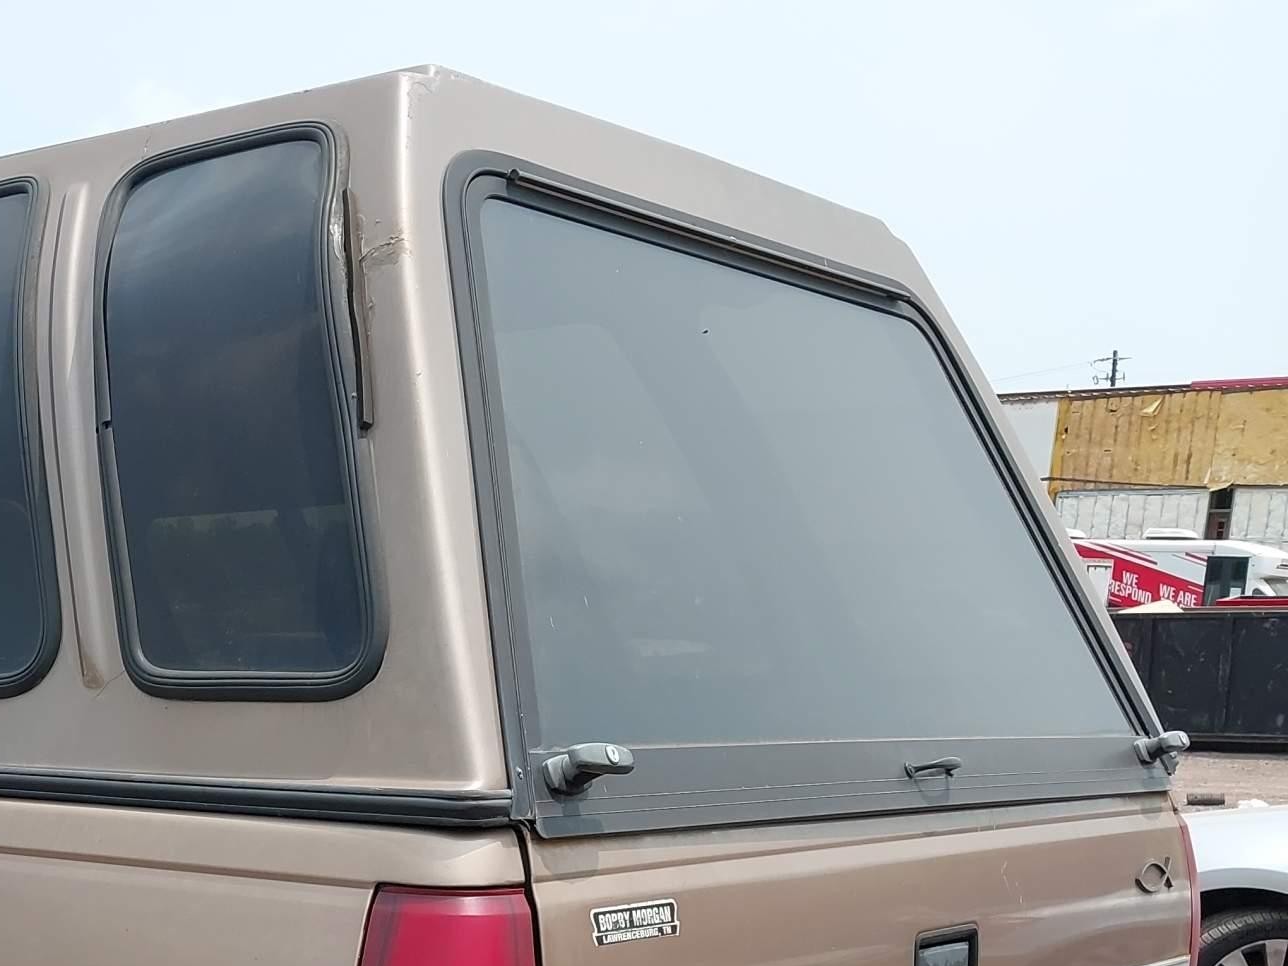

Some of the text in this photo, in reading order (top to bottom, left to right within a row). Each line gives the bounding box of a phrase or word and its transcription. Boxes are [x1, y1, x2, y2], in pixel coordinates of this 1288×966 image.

[1122, 570, 1139, 587] WE
[1159, 583, 1177, 602] WE
[1177, 591, 1198, 607] ARE
[632, 906, 672, 927] MORGAN
[663, 926, 673, 934] TN
